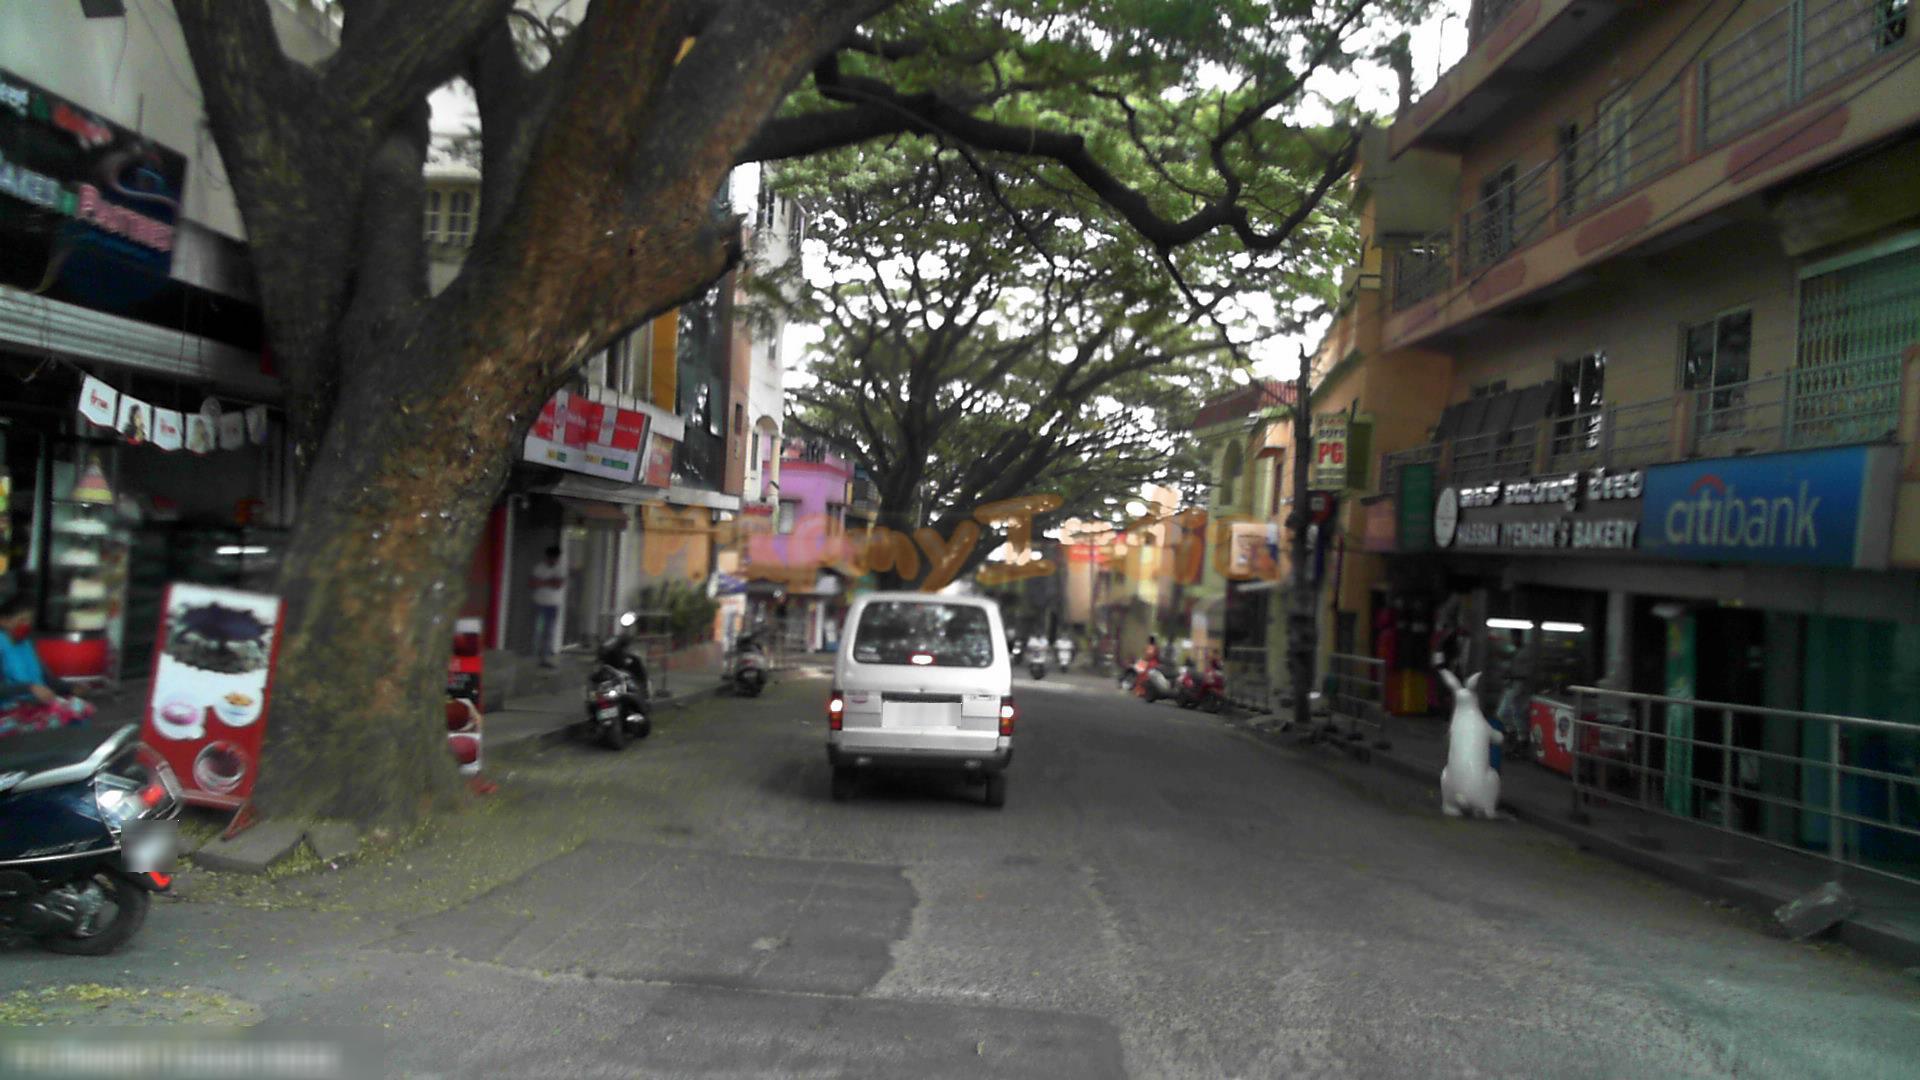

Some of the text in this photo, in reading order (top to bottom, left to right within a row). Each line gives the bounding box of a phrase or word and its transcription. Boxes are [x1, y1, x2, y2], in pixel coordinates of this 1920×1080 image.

[1317, 441, 1345, 464] PG
[1664, 478, 1822, 550] citibank
[1572, 519, 1638, 549] BAKERY
